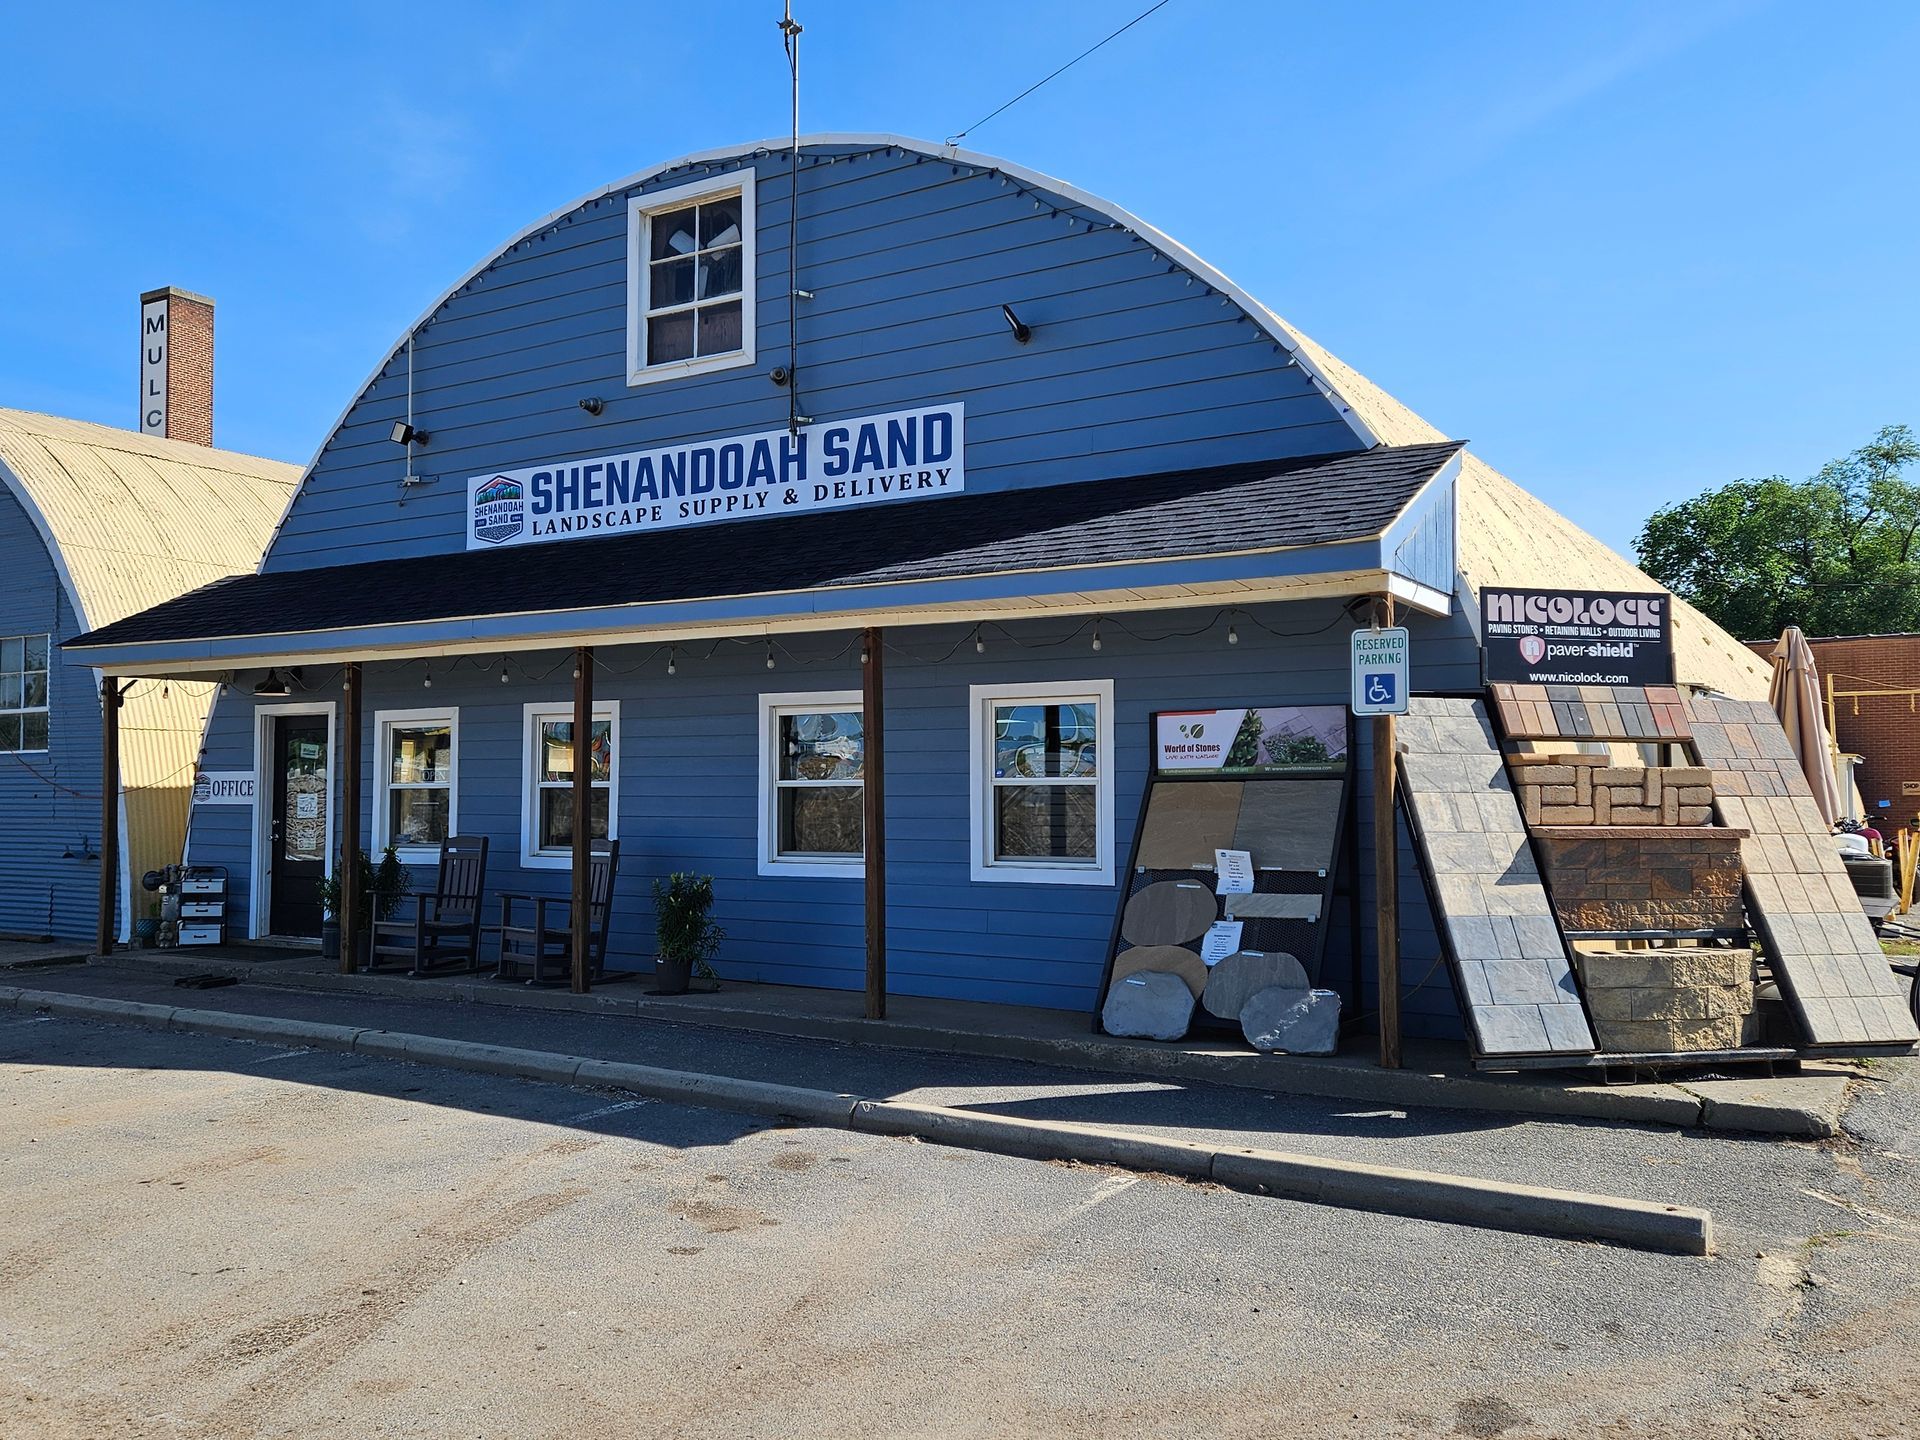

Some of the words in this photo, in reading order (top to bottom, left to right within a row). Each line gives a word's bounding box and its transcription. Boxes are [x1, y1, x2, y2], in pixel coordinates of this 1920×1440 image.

[531, 433, 807, 515] SHENANDOAH
[823, 411, 952, 477] SAND
[532, 505, 662, 536] LANDSCAPE
[679, 491, 769, 518] SUPPLY
[783, 488, 799, 505] &
[814, 468, 952, 501] DELIVERY
[475, 501, 523, 518] SHENANDOAH
[488, 513, 509, 525] SAND
[1487, 593, 1660, 627] NICOLOCK
[1488, 623, 1512, 634] PAVING
[1513, 624, 1538, 634] STONES
[1545, 625, 1579, 636] RETAINING
[1579, 626, 1602, 637] WALLS
[1608, 627, 1638, 638] OUTDOOR
[1639, 628, 1661, 638] LIVING
[1356, 637, 1404, 650] RESERVED
[1359, 652, 1401, 665] PARKING
[1529, 672, 1629, 684] www.nicolock.com
[1164, 744, 1186, 753] World
[1187, 744, 1194, 752] of
[1195, 743, 1221, 752] Stones
[423, 770, 446, 781] OPEN
[212, 780, 254, 796] OFFICE
